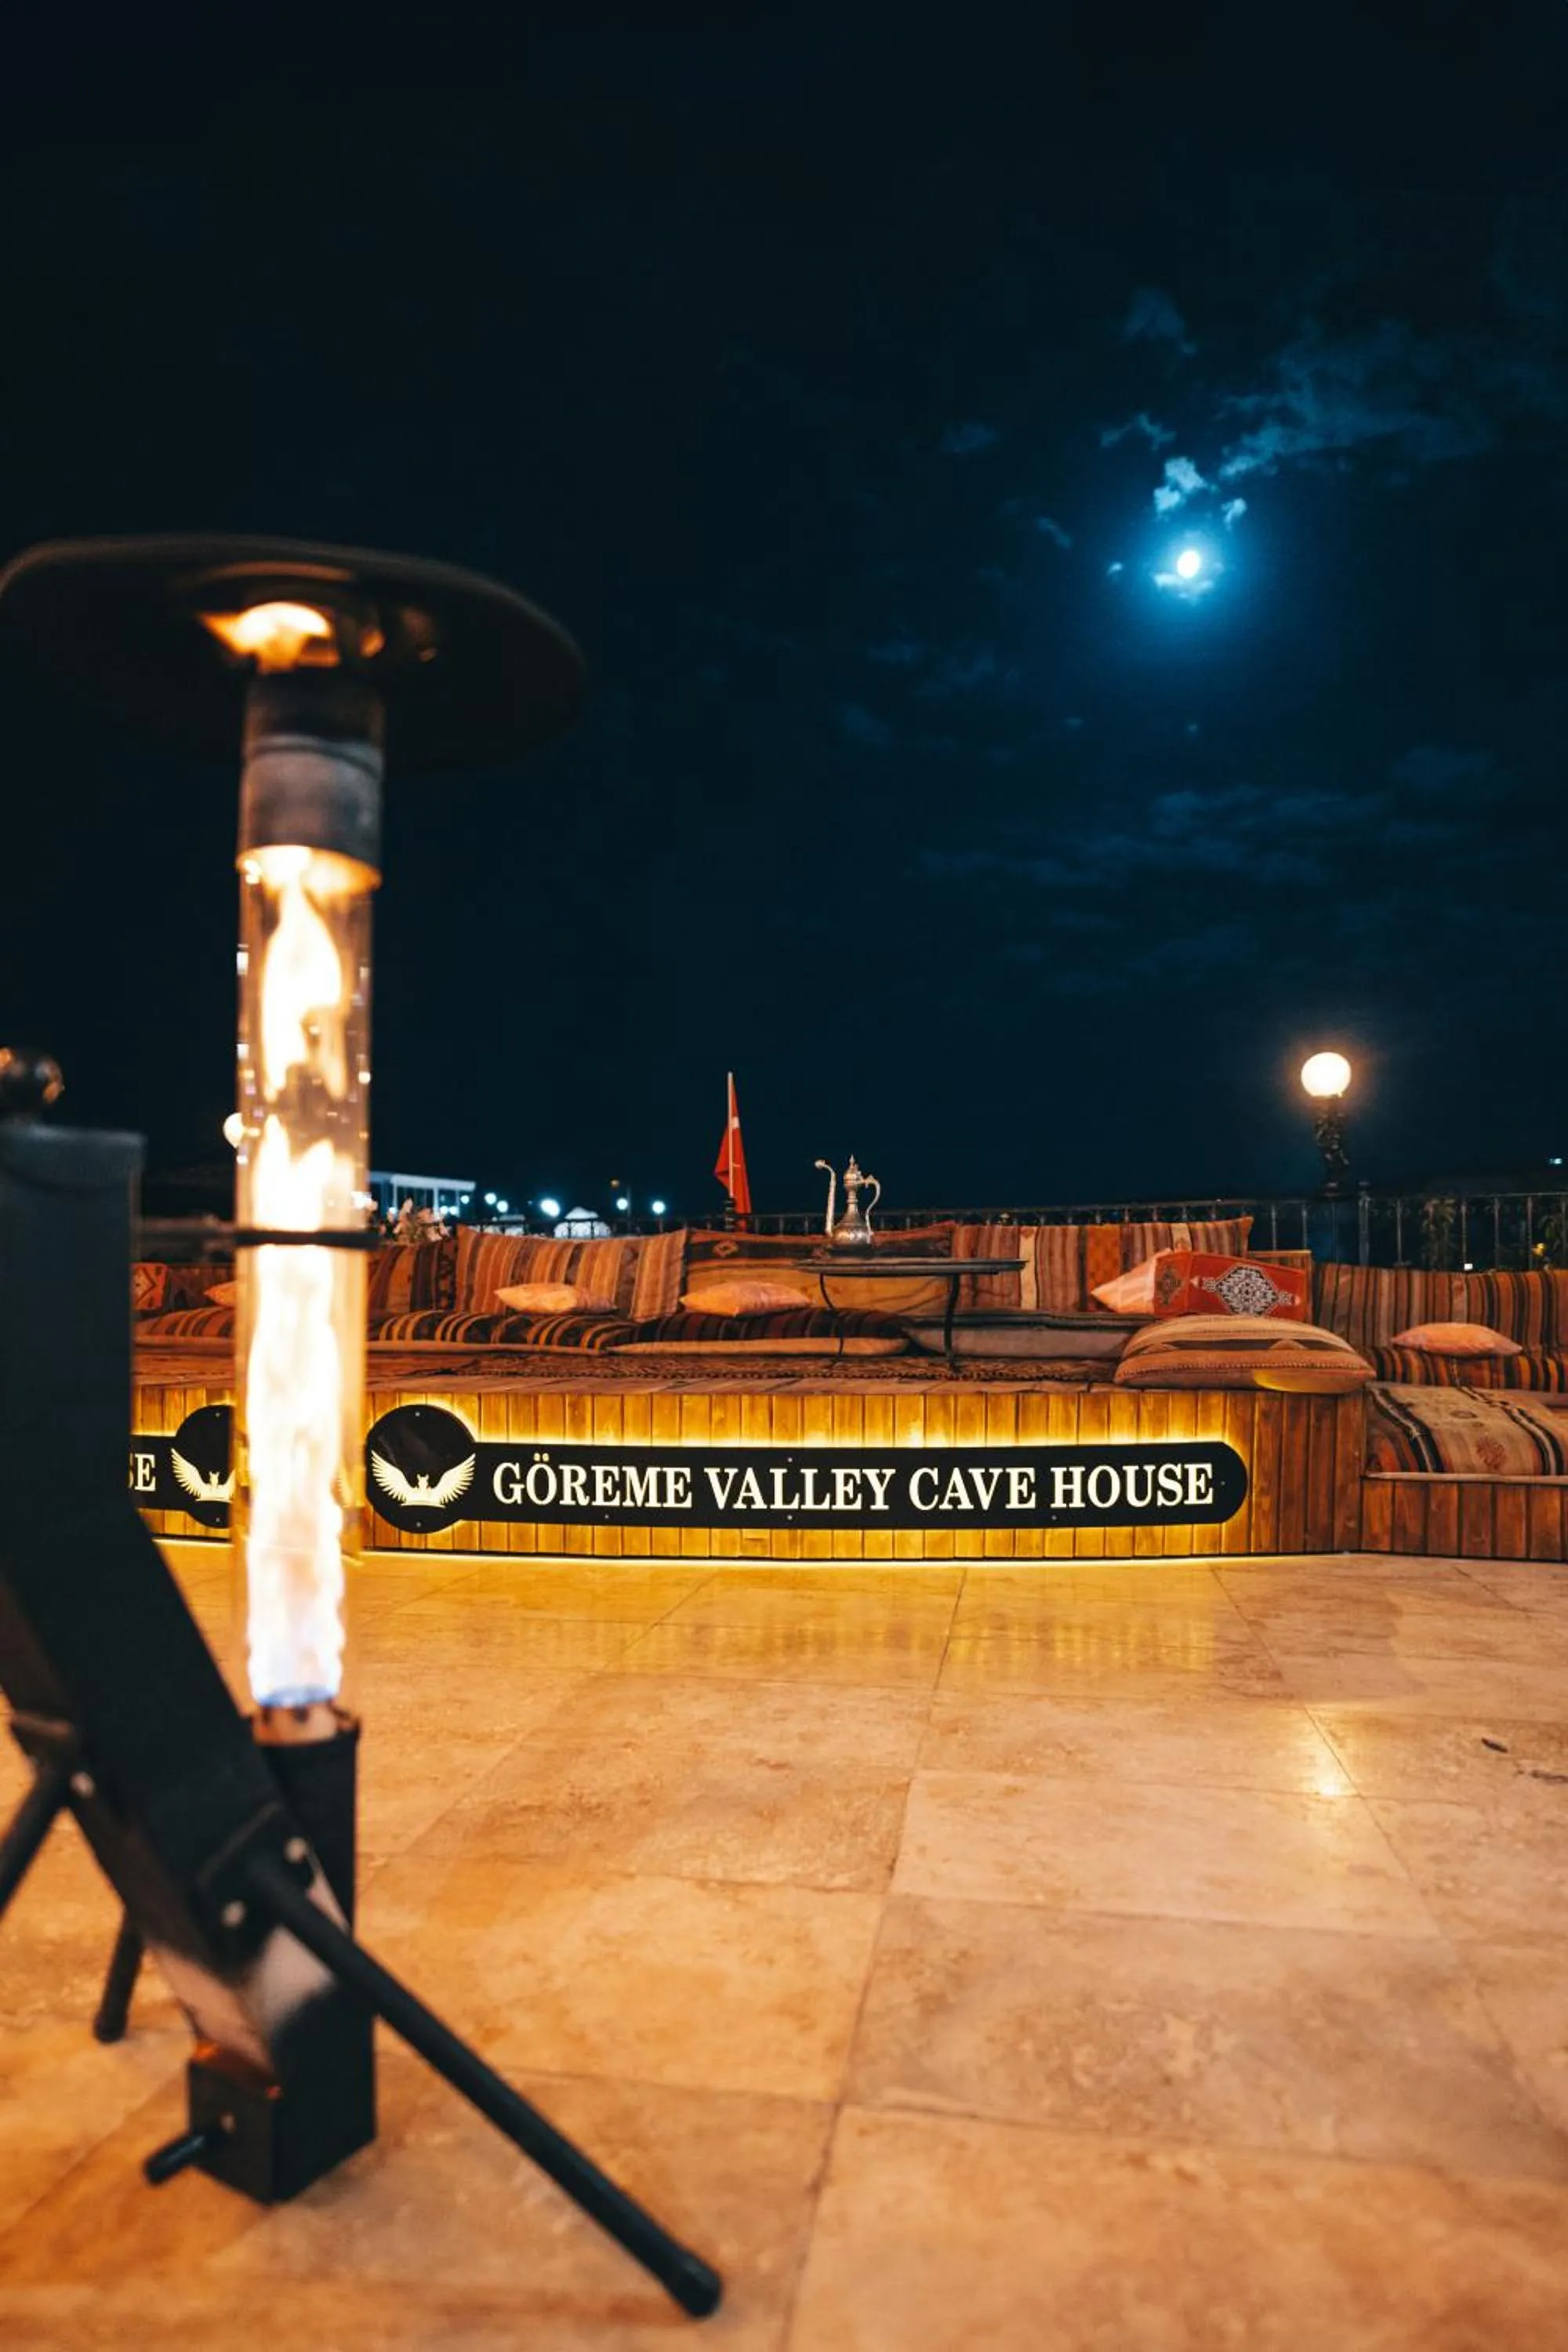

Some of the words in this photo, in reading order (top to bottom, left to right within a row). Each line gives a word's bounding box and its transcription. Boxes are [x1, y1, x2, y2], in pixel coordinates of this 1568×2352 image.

[129, 1453, 156, 1491] E
[492, 1453, 693, 1508] GÖREME
[703, 1467, 896, 1511] VALLEY
[908, 1466, 1037, 1511] CAVE
[1050, 1462, 1214, 1508] HOUSE
